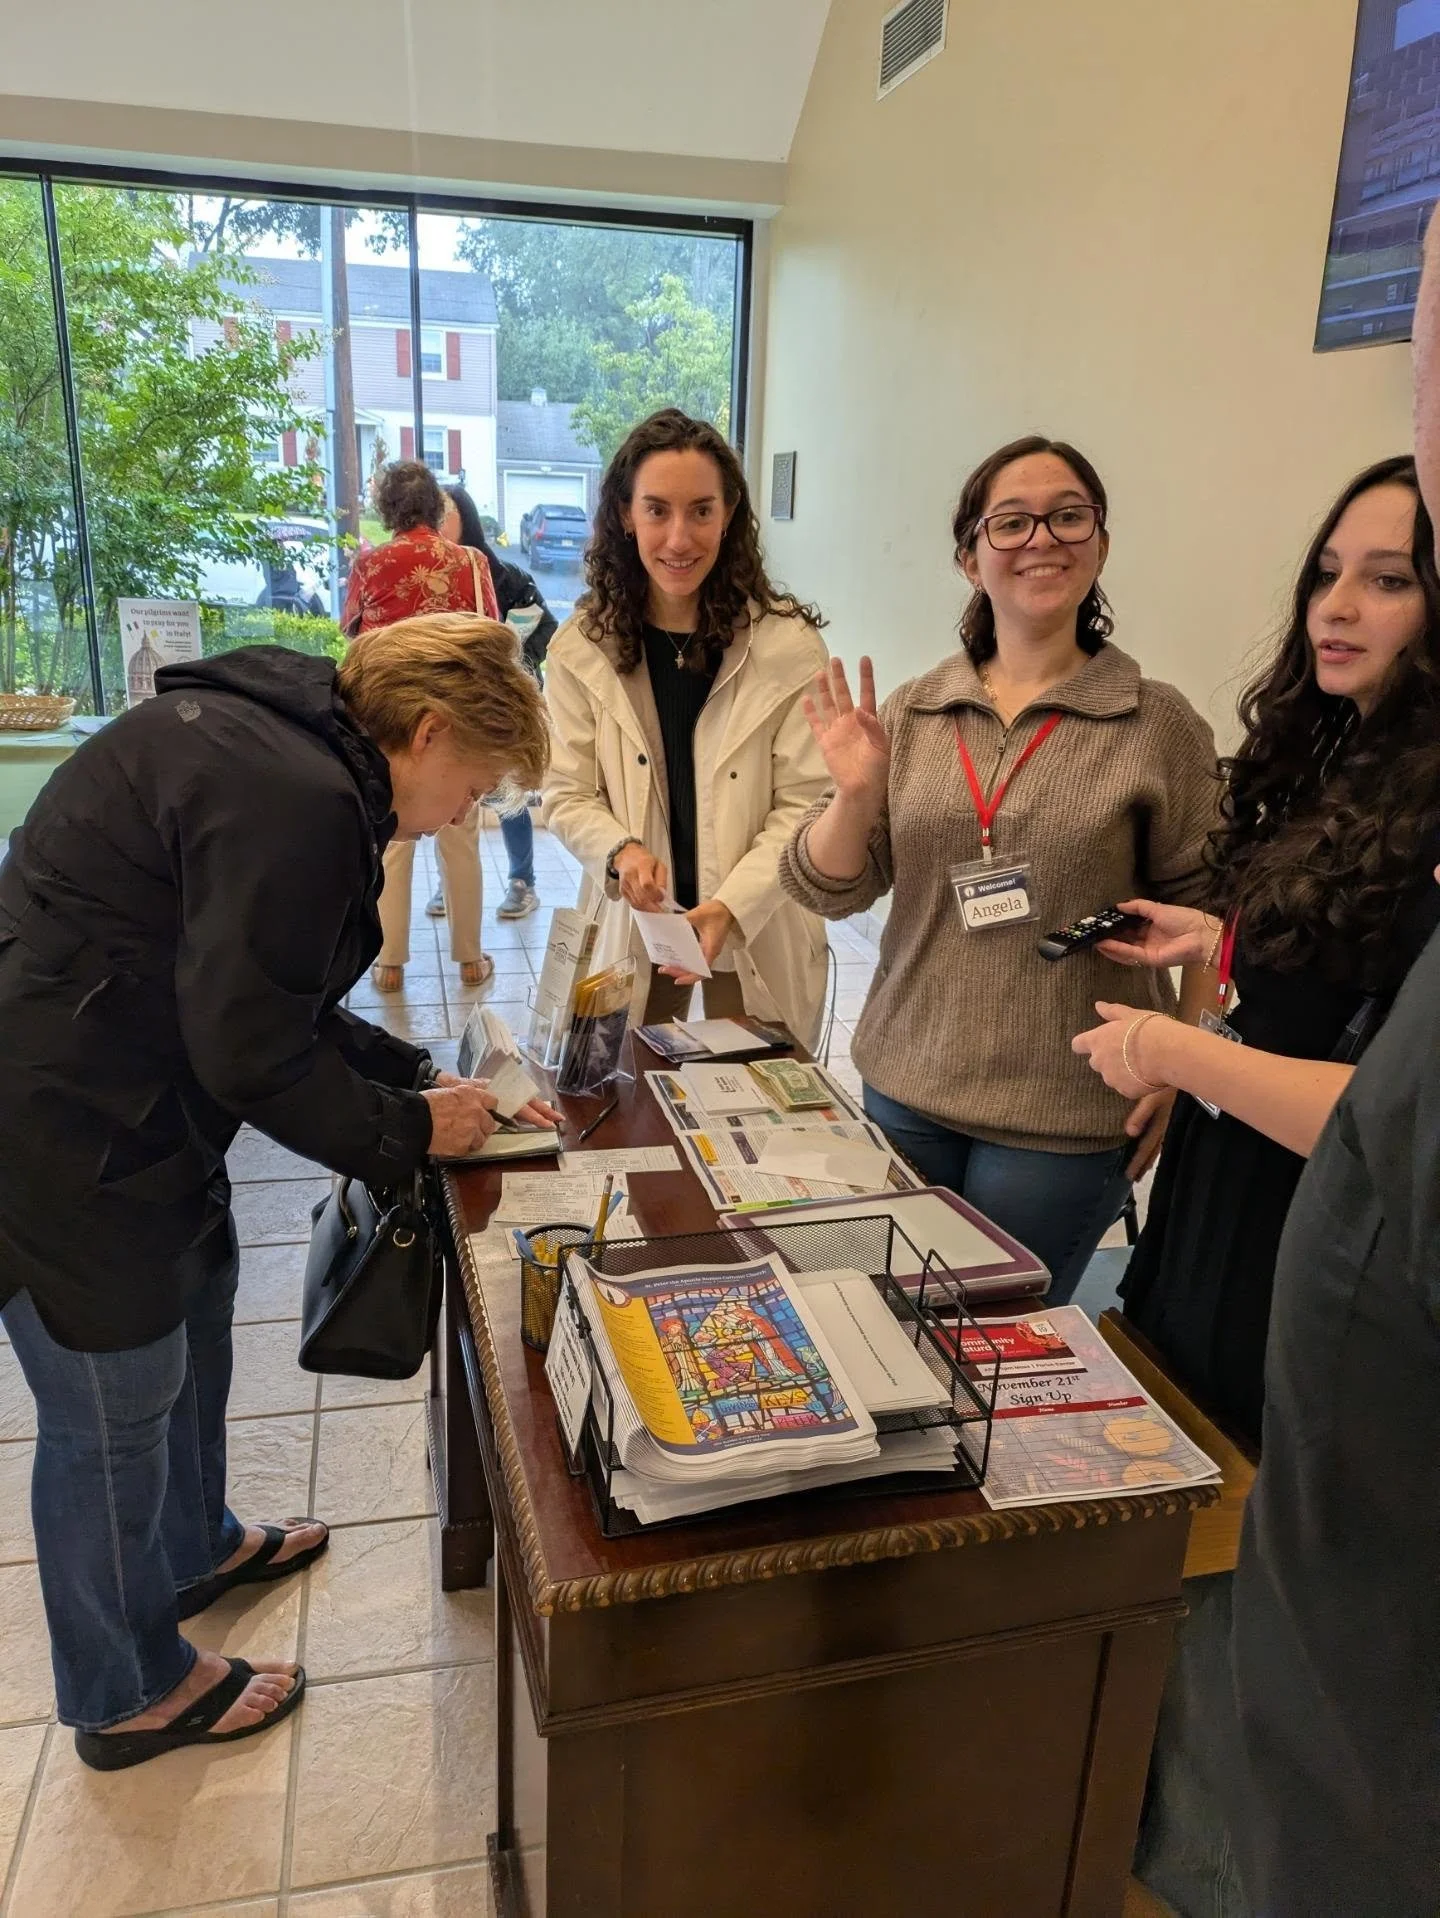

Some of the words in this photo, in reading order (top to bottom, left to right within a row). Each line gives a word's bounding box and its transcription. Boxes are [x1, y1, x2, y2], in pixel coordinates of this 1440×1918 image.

[144, 609, 172, 617] pilgrims
[174, 631, 191, 639] Italy!
[978, 878, 1016, 893] Welcome!
[971, 897, 1024, 920] Angela
[959, 1336, 1015, 1347] ommnity
[961, 1344, 1005, 1353] aturdy
[1057, 1374, 1080, 1386] 21st
[764, 1391, 807, 1407] KEYS
[1010, 1394, 1043, 1407] Sign
[1046, 1390, 1072, 1404] Up
